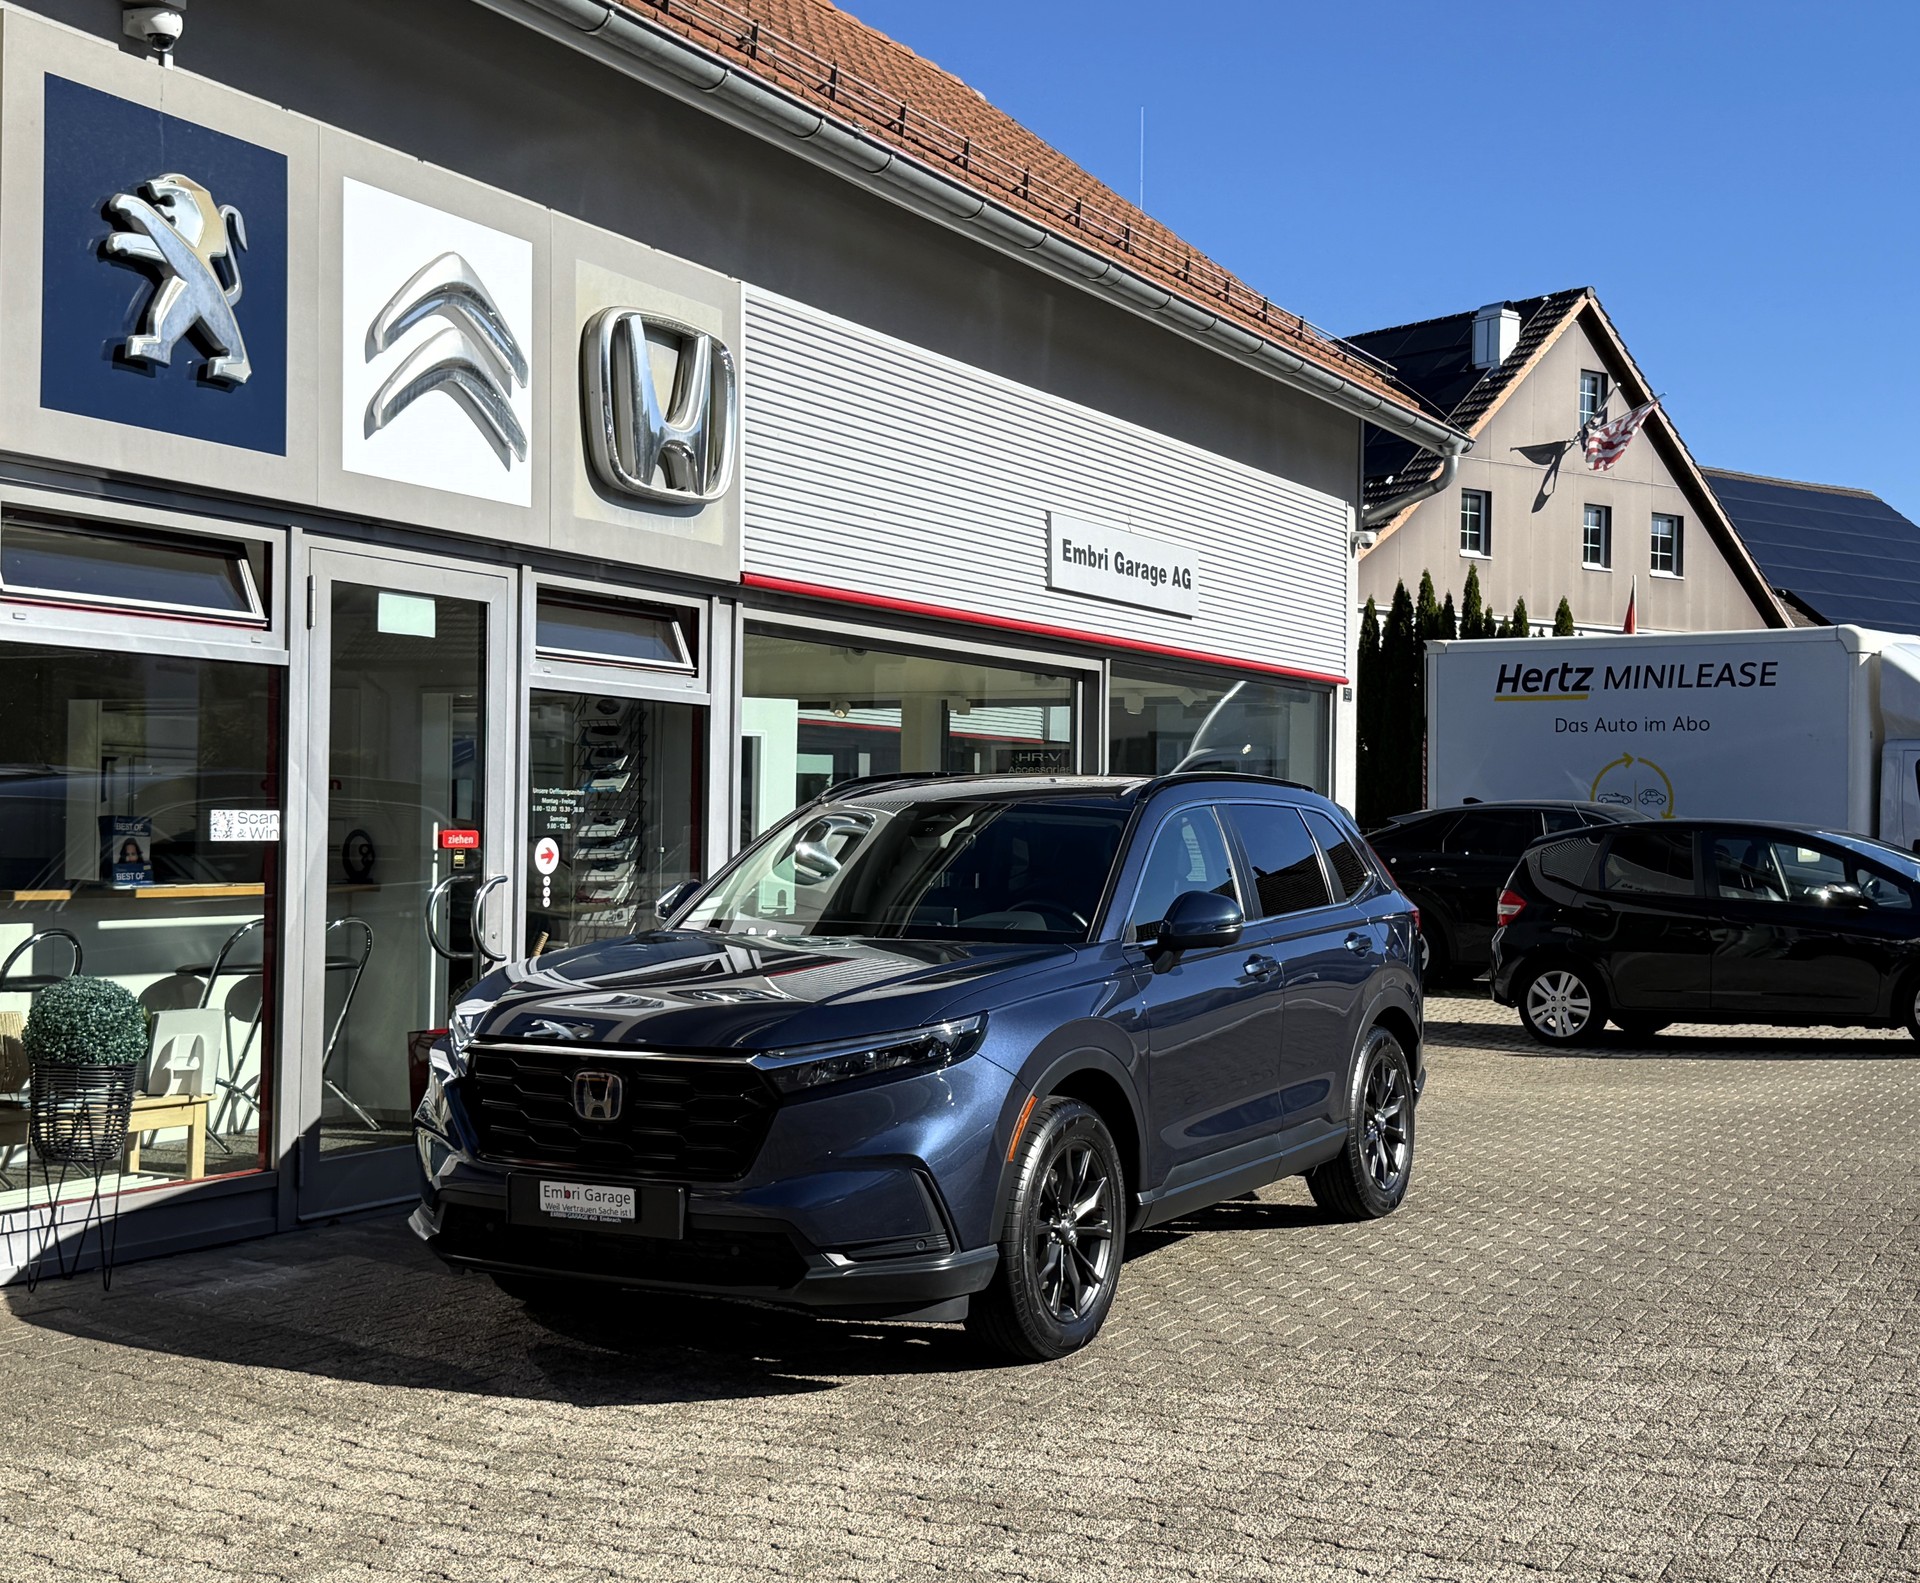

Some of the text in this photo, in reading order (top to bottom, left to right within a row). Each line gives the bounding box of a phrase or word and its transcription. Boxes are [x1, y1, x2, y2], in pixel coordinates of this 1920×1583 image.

[1062, 538, 1192, 590] Embri Garage AG
[1495, 661, 1779, 693] Hertz MINILEASE
[1555, 716, 1711, 733] Das Auto im Abo
[1018, 752, 1062, 762] HR-V
[237, 811, 280, 825] Scan
[115, 822, 144, 832] BEST OF
[237, 826, 280, 839] & Win
[447, 834, 474, 845] ziehen
[115, 872, 145, 881] BEST OF
[543, 1184, 631, 1208] Embri Garage
[562, 1203, 597, 1214] Vertrauen
[598, 1207, 619, 1216] Sache
[620, 1208, 628, 1217] ist
